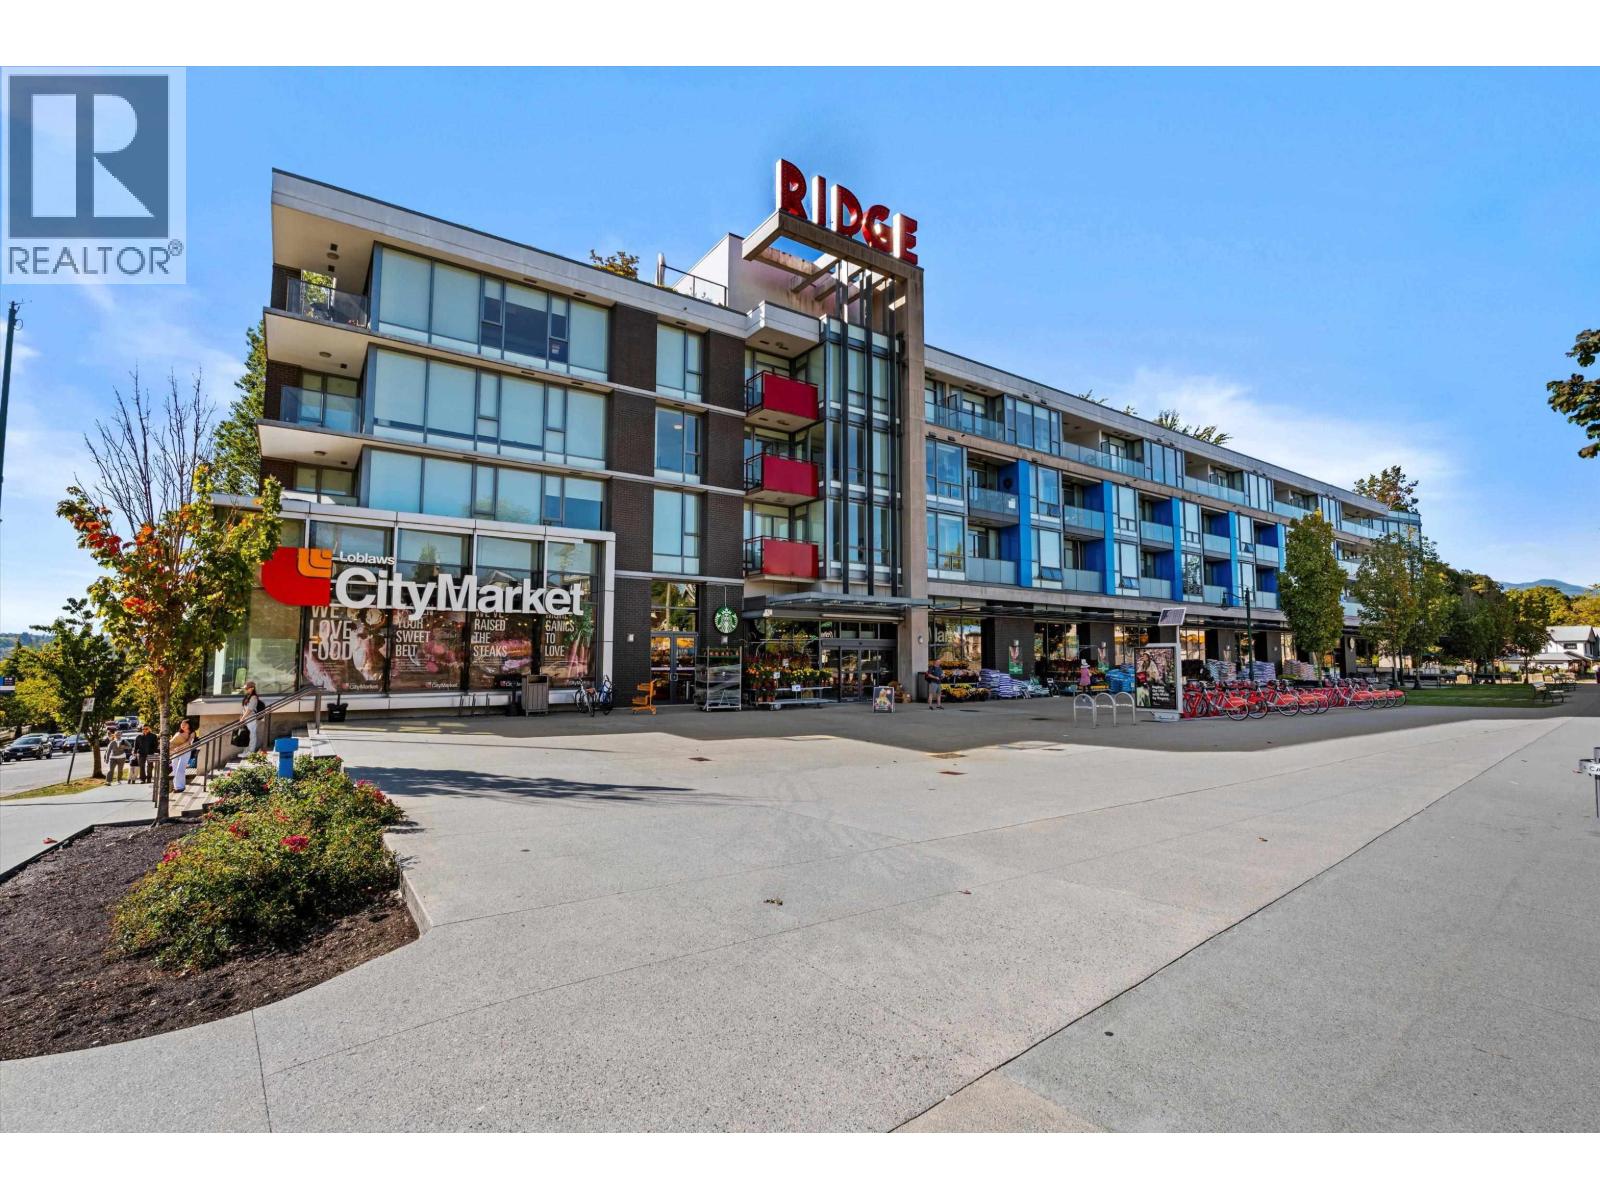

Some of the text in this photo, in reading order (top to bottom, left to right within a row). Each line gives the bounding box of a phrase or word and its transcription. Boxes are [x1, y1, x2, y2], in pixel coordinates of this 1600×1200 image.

[775, 158, 918, 266] RIDGE
[340, 552, 395, 565] Loblaws
[335, 567, 584, 621] CityMarket
[311, 605, 341, 618] WE
[308, 619, 353, 640] LOVE
[474, 618, 506, 631] RAISED
[395, 630, 431, 643] SWEET
[473, 631, 491, 644] THE
[545, 632, 556, 644] TO
[307, 640, 354, 661] FOOD
[395, 644, 418, 657] BELT
[473, 645, 508, 657] STEAKS
[544, 645, 565, 657] LOVE
